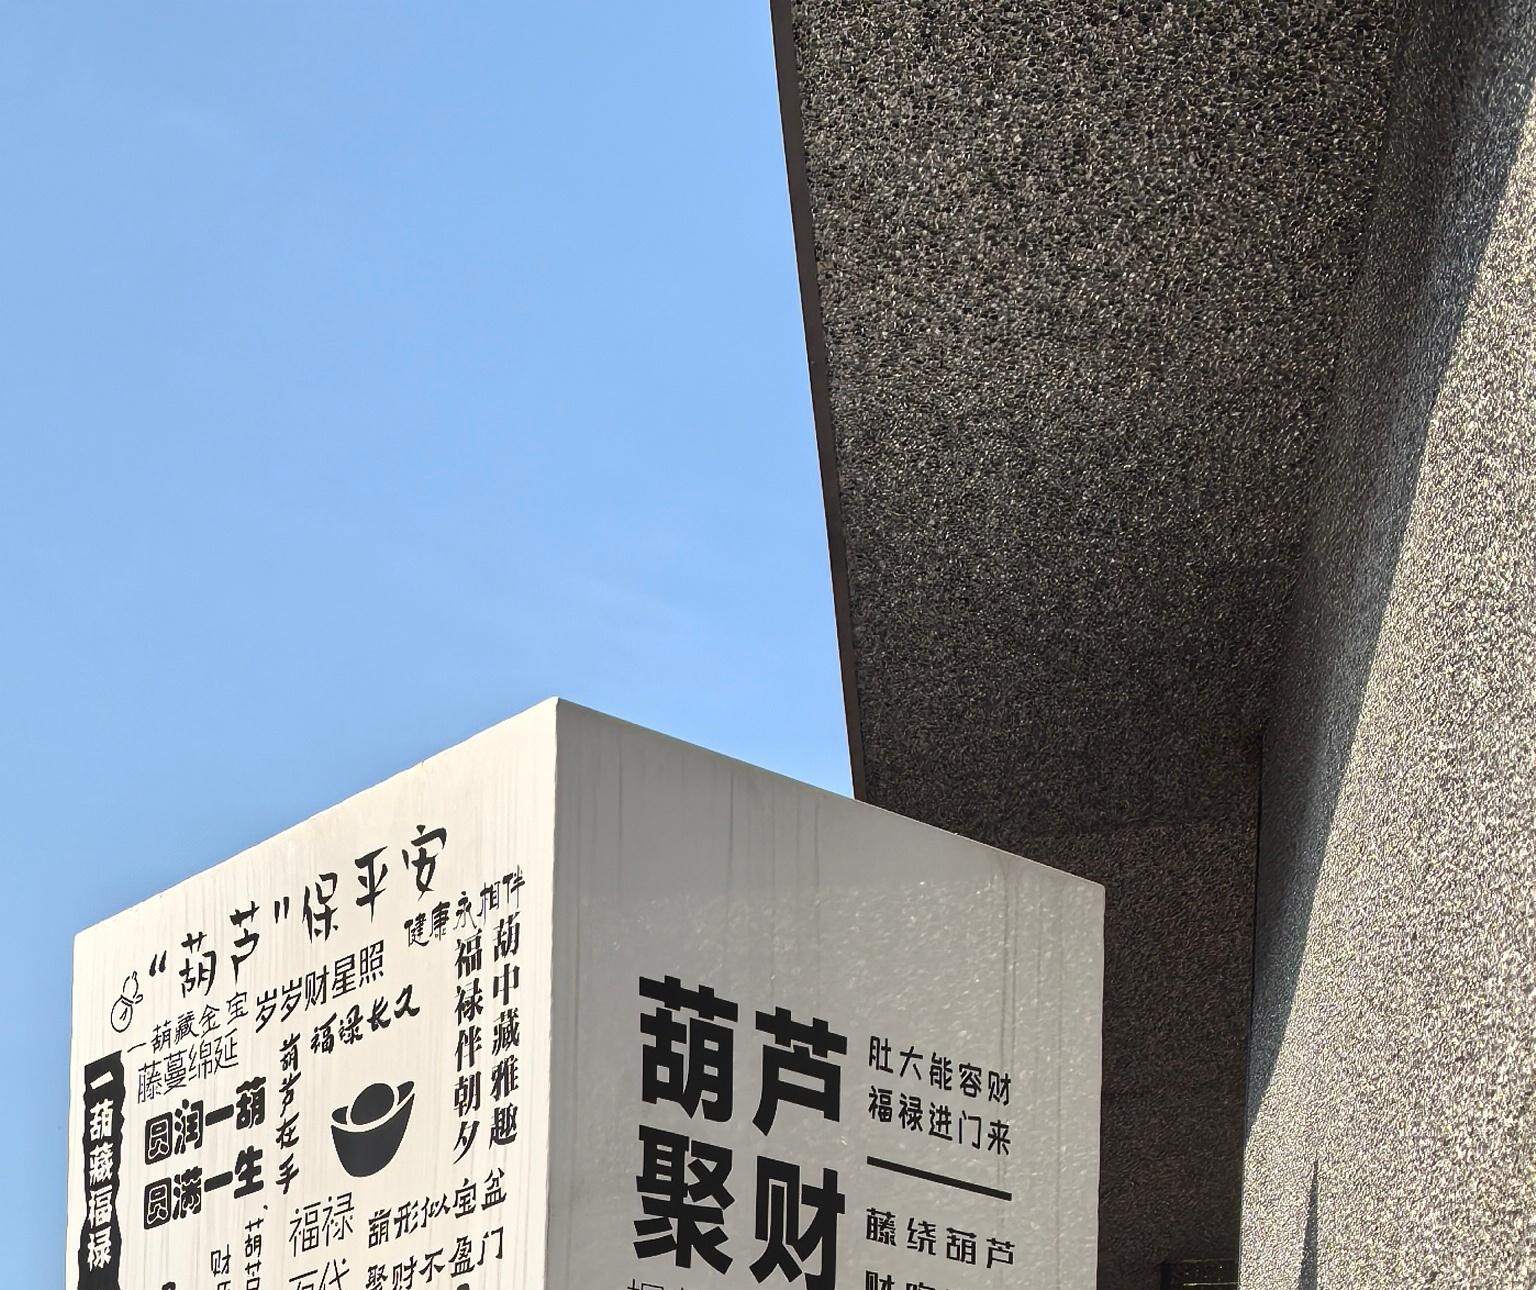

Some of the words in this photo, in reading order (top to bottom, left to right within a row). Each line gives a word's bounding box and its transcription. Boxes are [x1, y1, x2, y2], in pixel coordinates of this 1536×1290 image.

[404, 863, 525, 948] 健康永相伴
[126, 992, 249, 1052] 一葫藏金宝
[255, 940, 385, 1033] 岁岁财星照
[311, 984, 420, 1054] 福禄长久
[137, 1029, 239, 1103] 藤蔓绵延
[453, 931, 484, 1165] 福禄伴朝夕
[488, 911, 521, 1150] 葫中藏雅趣
[639, 975, 847, 1136] 葫芦
[868, 1035, 1011, 1105] 肚大能容财
[145, 1076, 266, 1165] 圆润一葫
[276, 1033, 301, 1195] 葫芦在手
[868, 1085, 1010, 1155] 福禄进门来
[86, 1071, 116, 1272] 一葫藏福禄
[144, 1146, 265, 1230] 圆满一生
[367, 1167, 507, 1249] 葫形似宝盆
[288, 1192, 355, 1257] 福禄
[866, 1207, 1015, 1269] 藤绕葫芦
